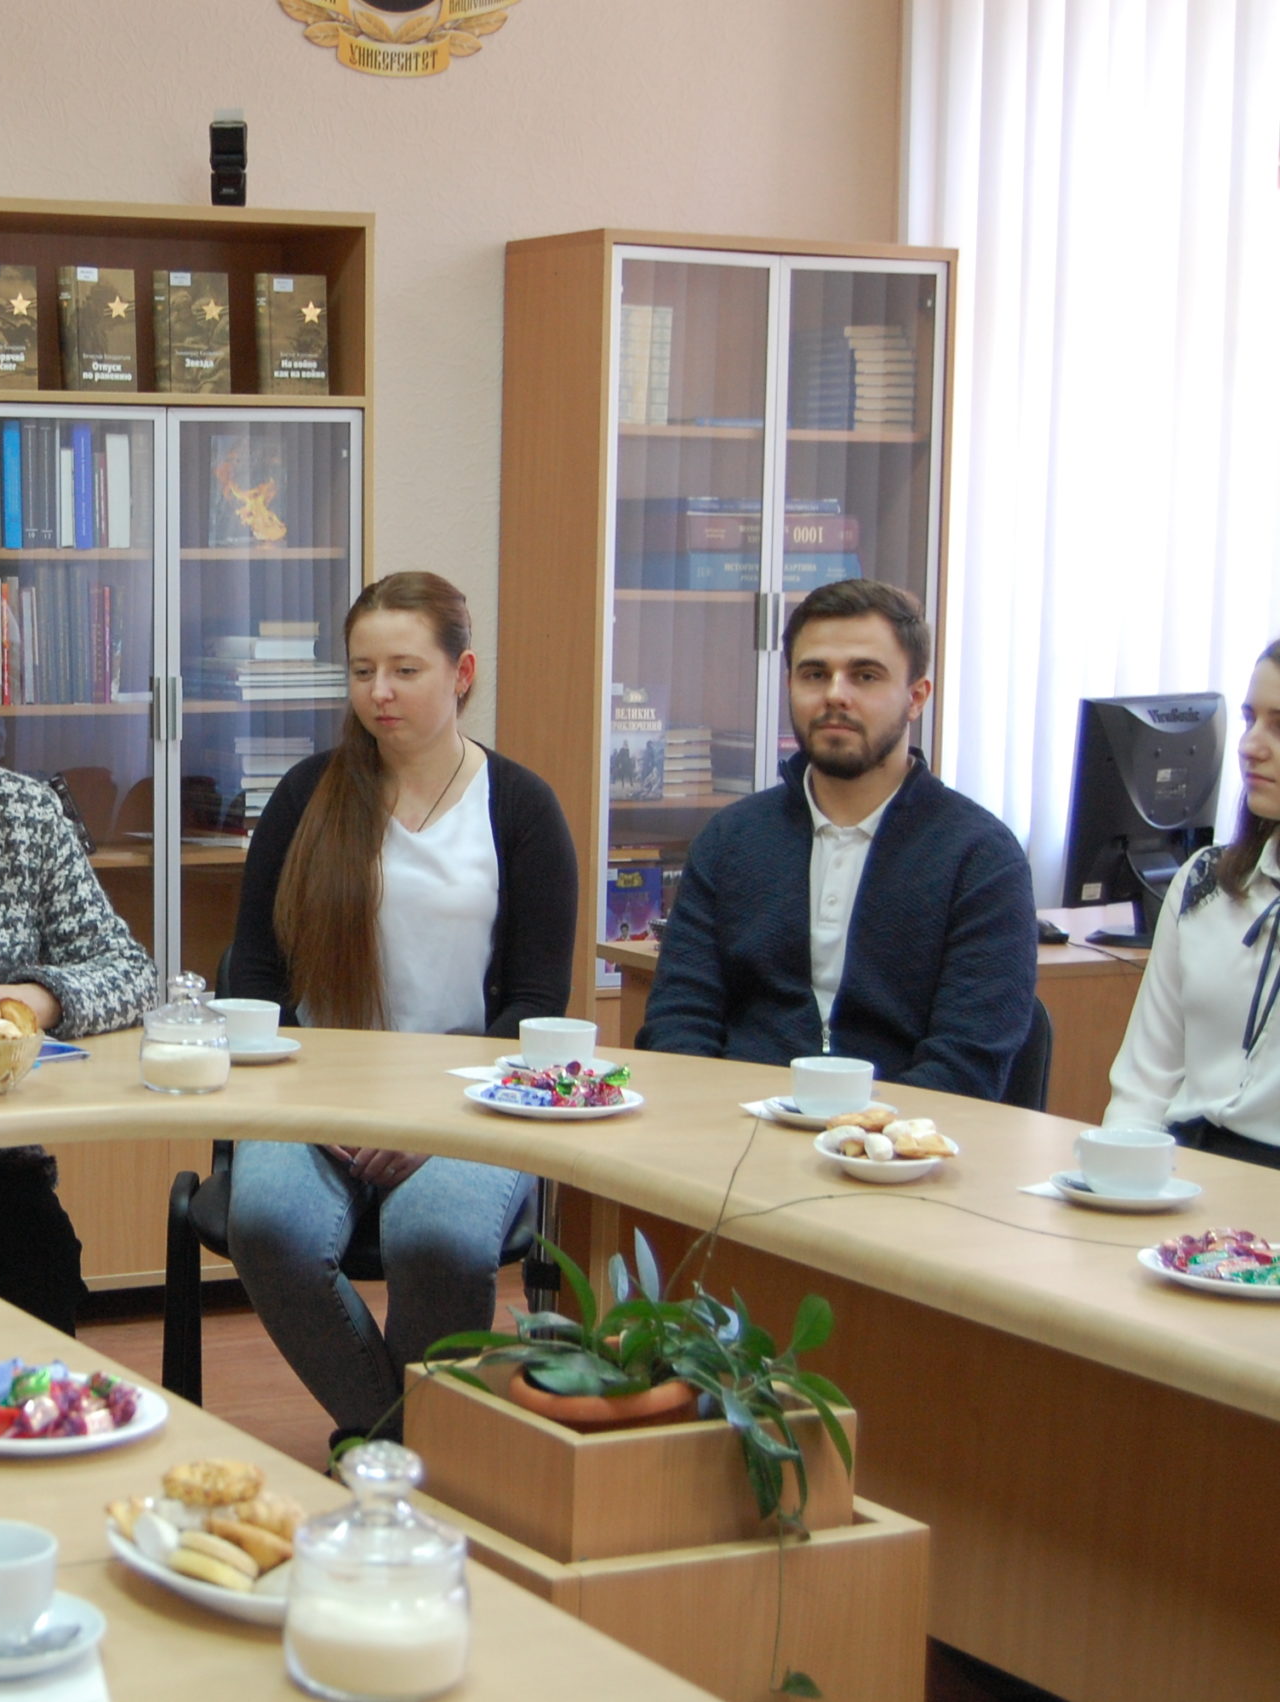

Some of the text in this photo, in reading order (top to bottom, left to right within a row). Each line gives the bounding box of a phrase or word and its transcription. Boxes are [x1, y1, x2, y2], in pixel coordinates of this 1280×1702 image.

[348, 43, 438, 73] УНИВЕРСИТЕТ
[0, 361, 17, 371] снег
[92, 360, 123, 374] Отпуск
[184, 357, 216, 369] Звезда
[281, 359, 318, 370] На войне
[82, 371, 133, 382] по ранению
[273, 369, 326, 380] как на войне
[793, 525, 824, 544] 1000
[615, 707, 657, 721] ВЕЛИКИХ
[612, 719, 663, 732] РИКЛЮЧЕНИЙ
